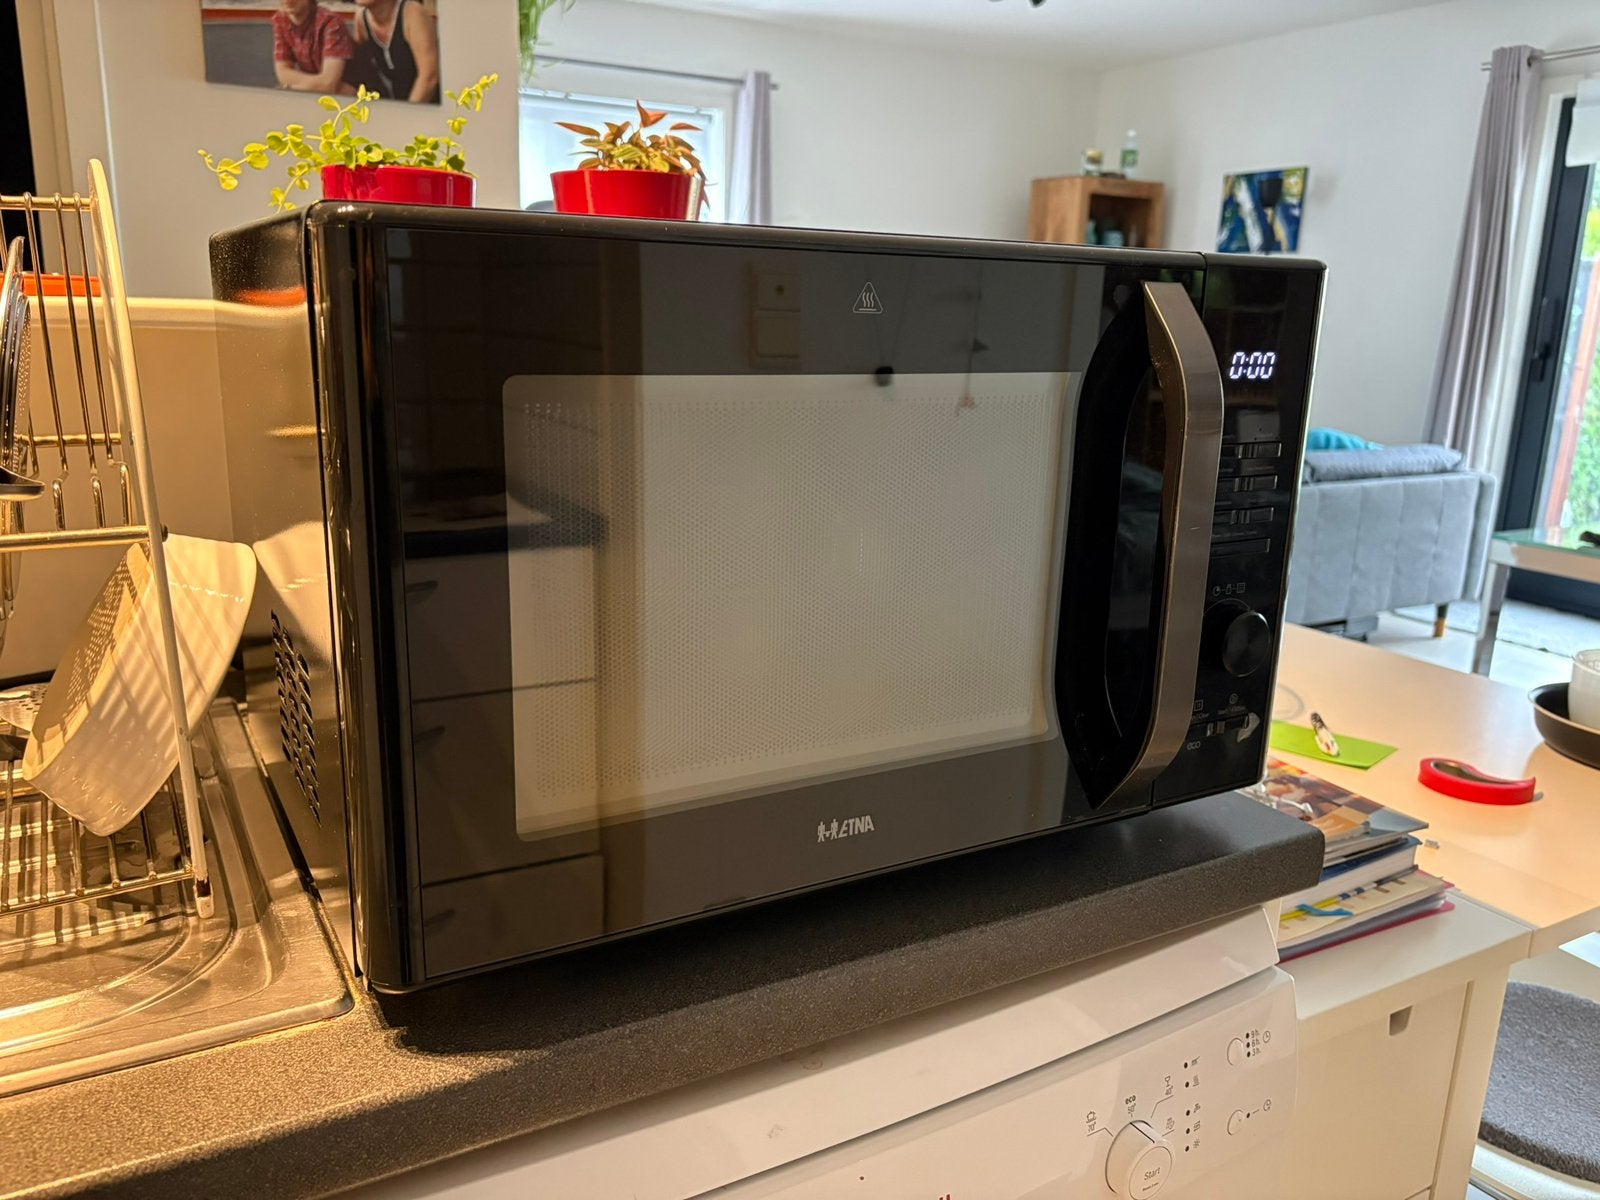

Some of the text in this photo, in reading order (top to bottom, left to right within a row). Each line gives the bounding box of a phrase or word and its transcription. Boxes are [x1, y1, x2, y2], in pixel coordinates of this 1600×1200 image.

[1230, 352, 1276, 379] 0:00
[838, 815, 875, 838] ETNA
[1125, 1095, 1137, 1105] eco
[1144, 1167, 1160, 1181] Start
